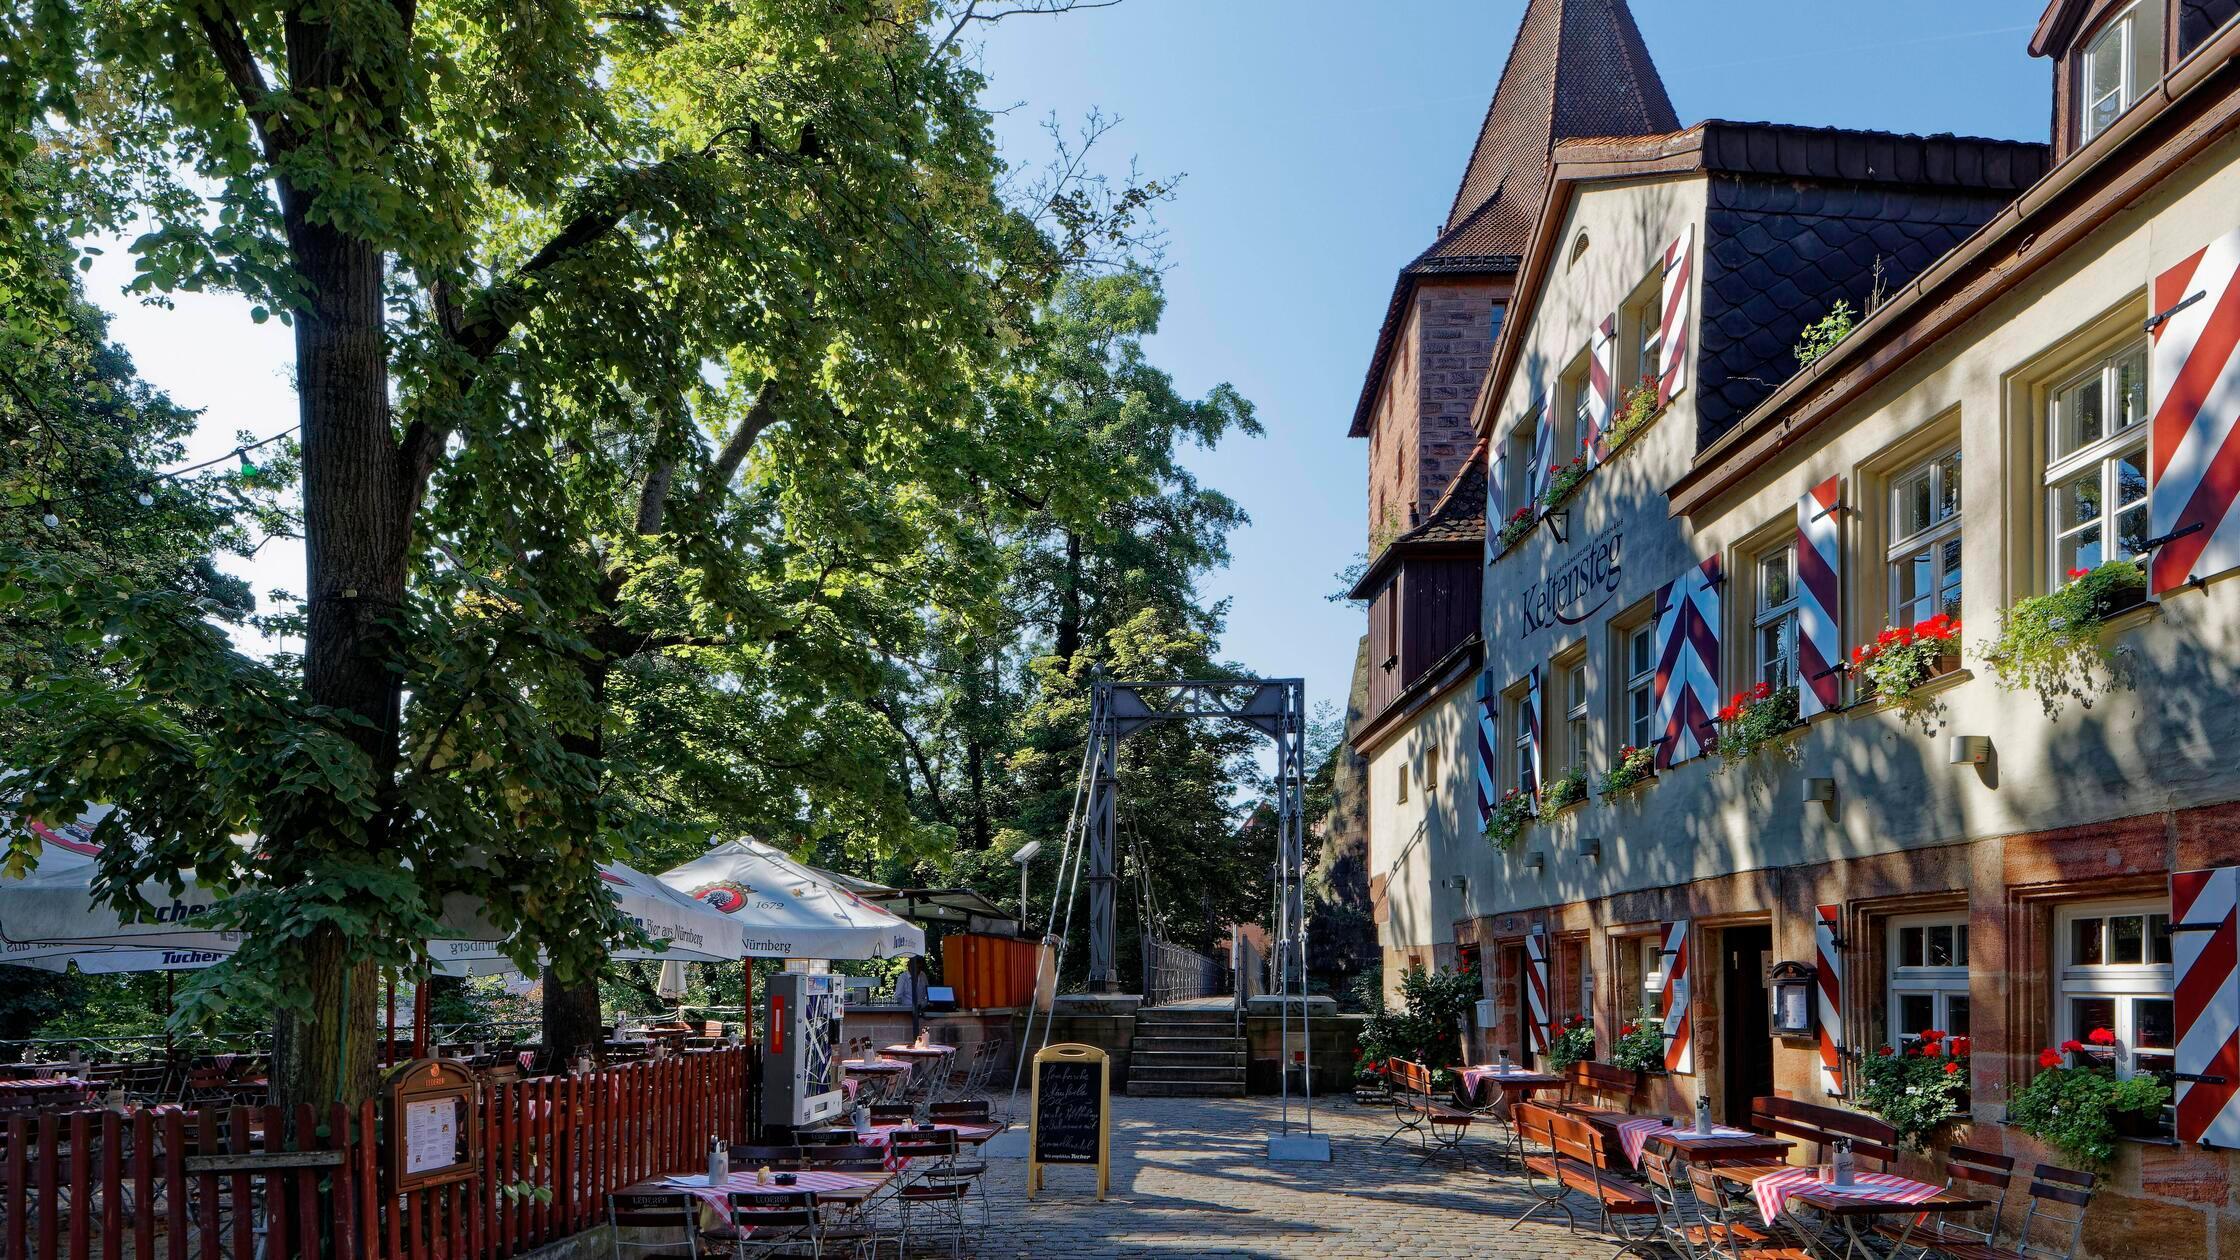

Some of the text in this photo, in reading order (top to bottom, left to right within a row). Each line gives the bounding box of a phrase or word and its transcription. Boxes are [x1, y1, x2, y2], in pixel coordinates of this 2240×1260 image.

[1521, 532, 1623, 640] Kettensteg
[755, 901, 785, 910] 1672
[673, 924, 703, 948] Nürnberg
[742, 938, 791, 953] Nürnberg
[161, 950, 223, 964] Tucher
[632, 1195, 668, 1205] LEDERER
[755, 1195, 790, 1204] LEDERER
